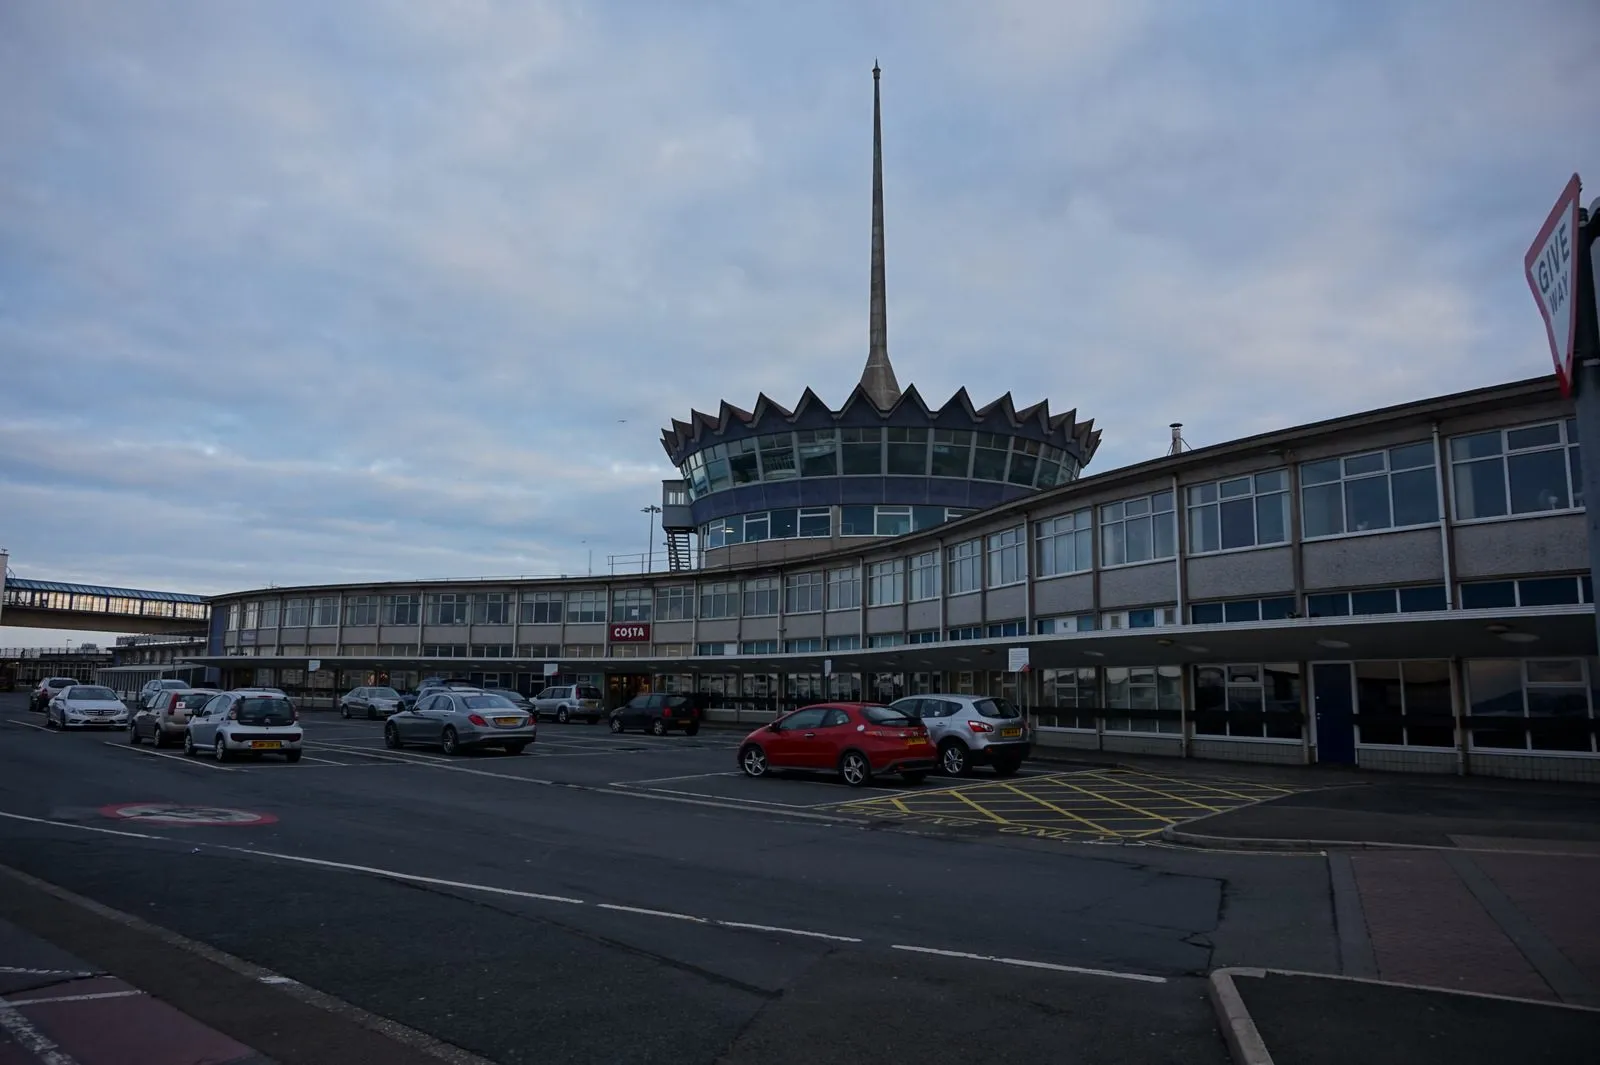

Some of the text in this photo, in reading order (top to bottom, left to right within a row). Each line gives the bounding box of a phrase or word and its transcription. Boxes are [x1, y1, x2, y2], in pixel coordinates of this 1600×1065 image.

[1538, 223, 1570, 294] GIVE
[1549, 270, 1569, 316] WAY
[614, 627, 644, 638] COSTA
[998, 826, 1123, 844] ONLY
